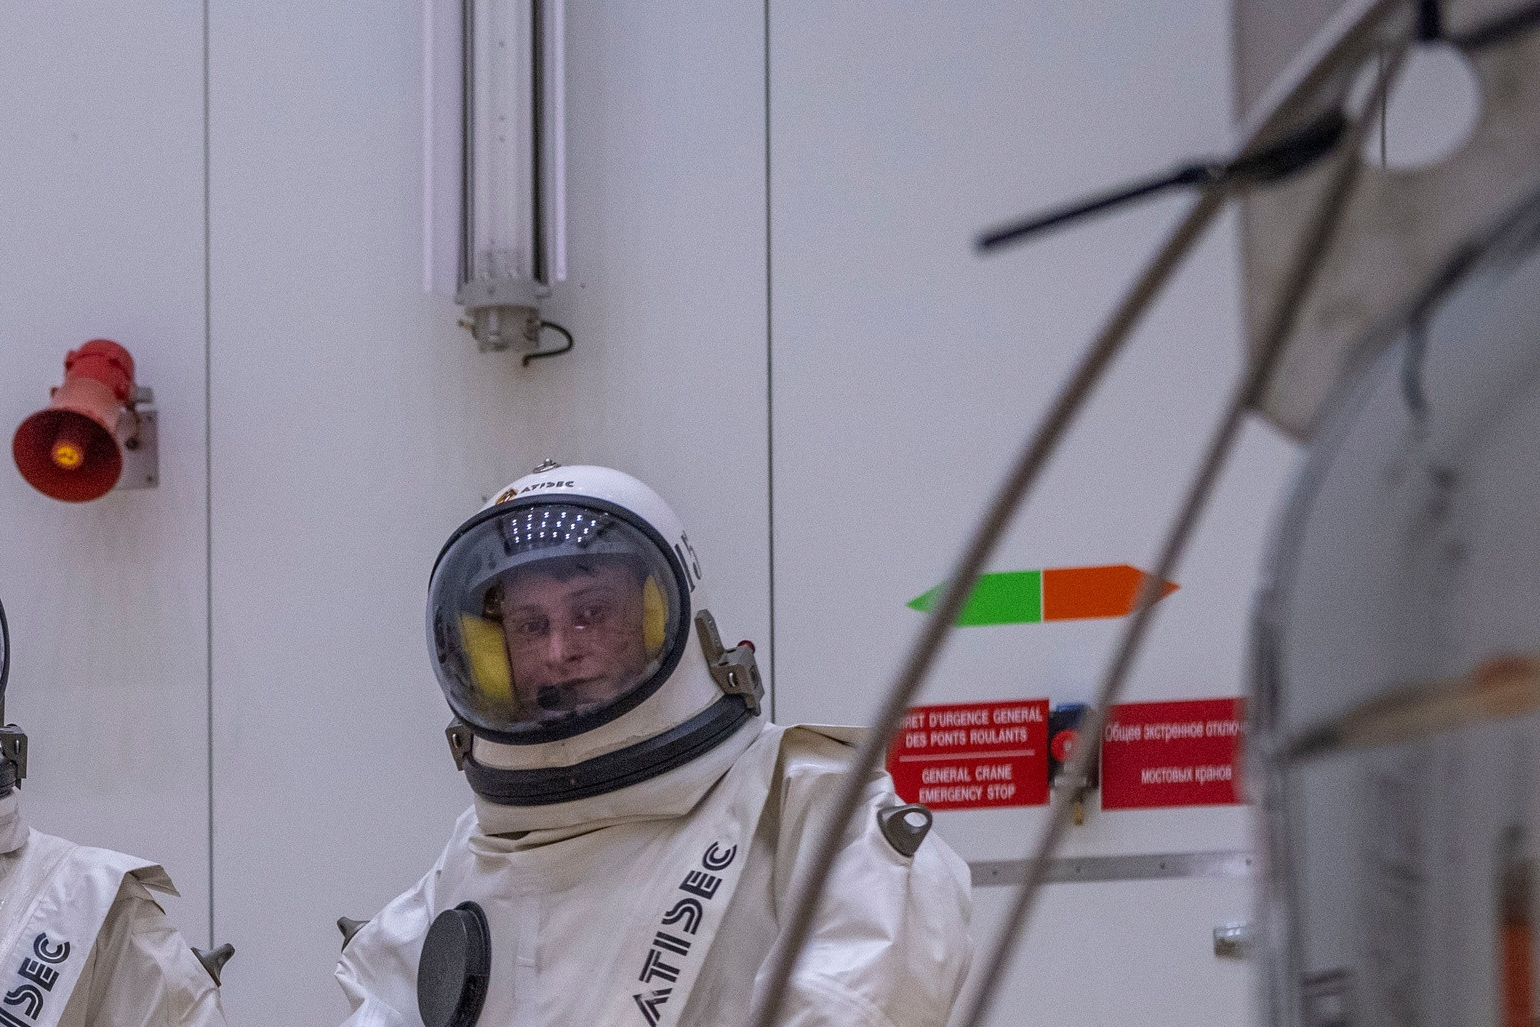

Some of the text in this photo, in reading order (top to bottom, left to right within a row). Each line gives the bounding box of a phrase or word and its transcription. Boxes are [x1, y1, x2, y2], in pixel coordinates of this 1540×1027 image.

[898, 705, 1043, 730] RRET D'URGENCE GENERAL
[905, 726, 1028, 748] DES PONTS ROULANTS
[1104, 723, 1141, 744] Общее
[1144, 721, 1204, 743] экстренное
[922, 763, 1013, 784] GENERAL CRANE
[1141, 764, 1232, 785] мостовых кранов
[918, 783, 1016, 803] EMERGENCY STOP
